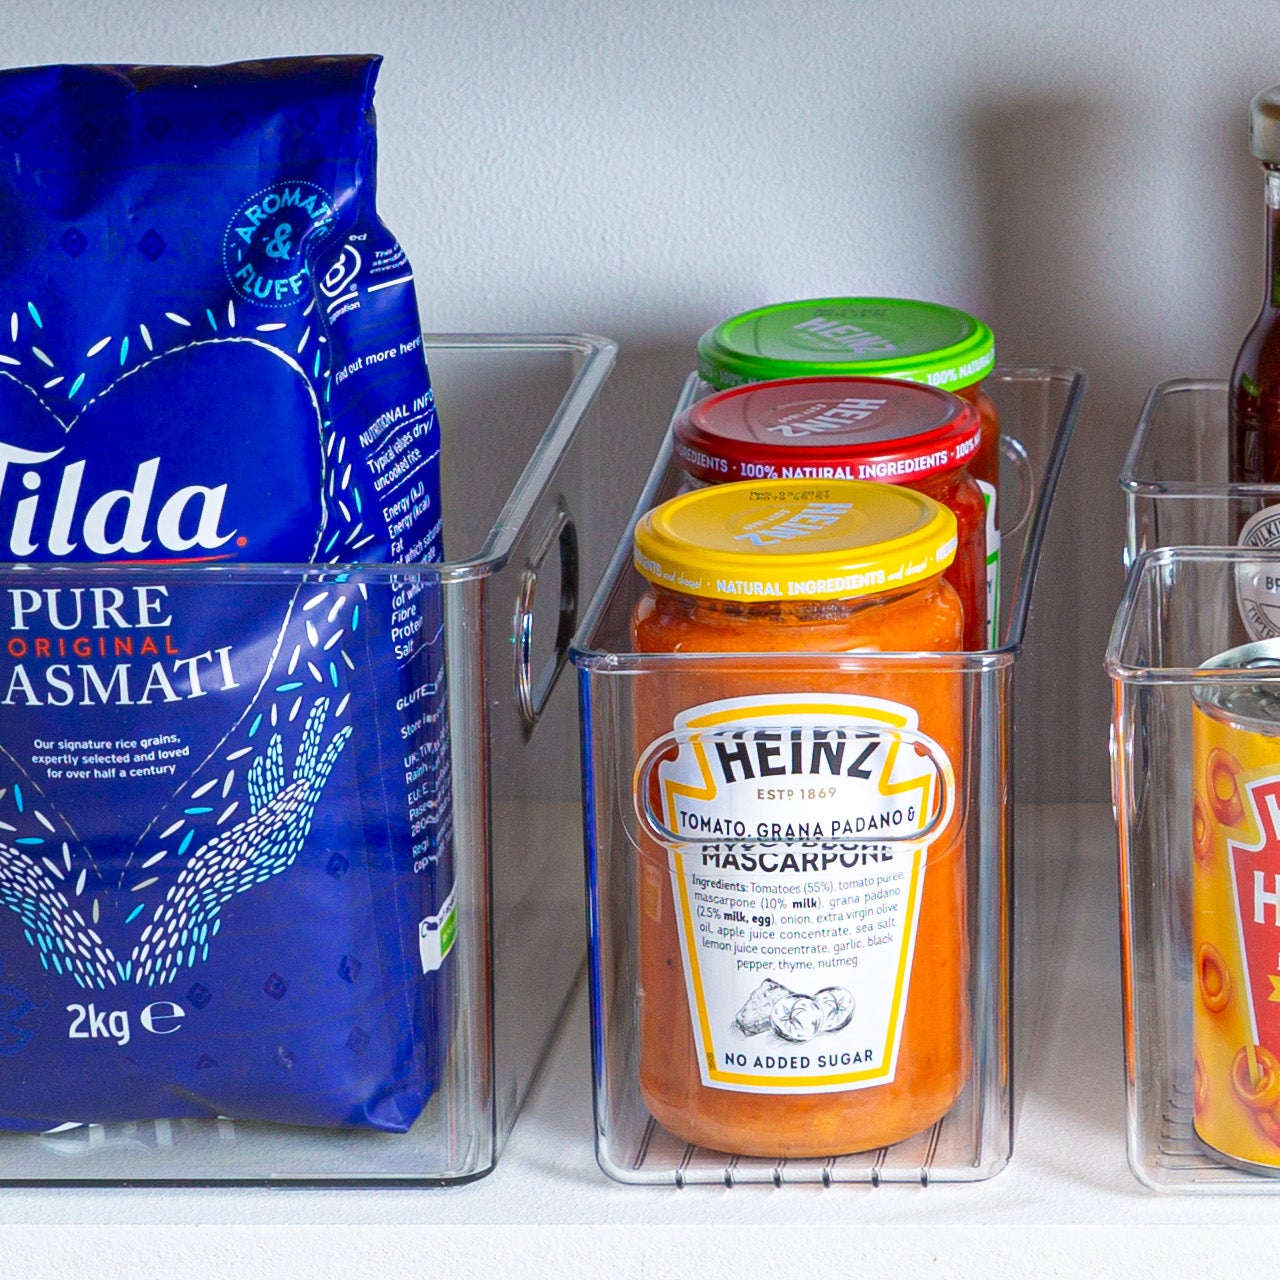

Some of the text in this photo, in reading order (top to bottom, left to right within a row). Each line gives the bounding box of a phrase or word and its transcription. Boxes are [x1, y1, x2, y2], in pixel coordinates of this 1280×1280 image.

[741, 451, 947, 478] 100% INGREDIENTS
[717, 570, 884, 596] NATURAL INGREDIENTS
[8, 586, 173, 631] PURE
[9, 637, 179, 655] ORIGINAL
[395, 641, 414, 660] Salt
[34, 735, 181, 752] Our signature rice grains,
[800, 788, 837, 799] 1869
[831, 811, 903, 836] PADANO
[692, 874, 800, 894] Ingredients: Tomatoes
[695, 892, 755, 908] mascarpone
[67, 1004, 130, 1045] 2kg
[725, 1050, 873, 1069] NO ADDED SUGAR
